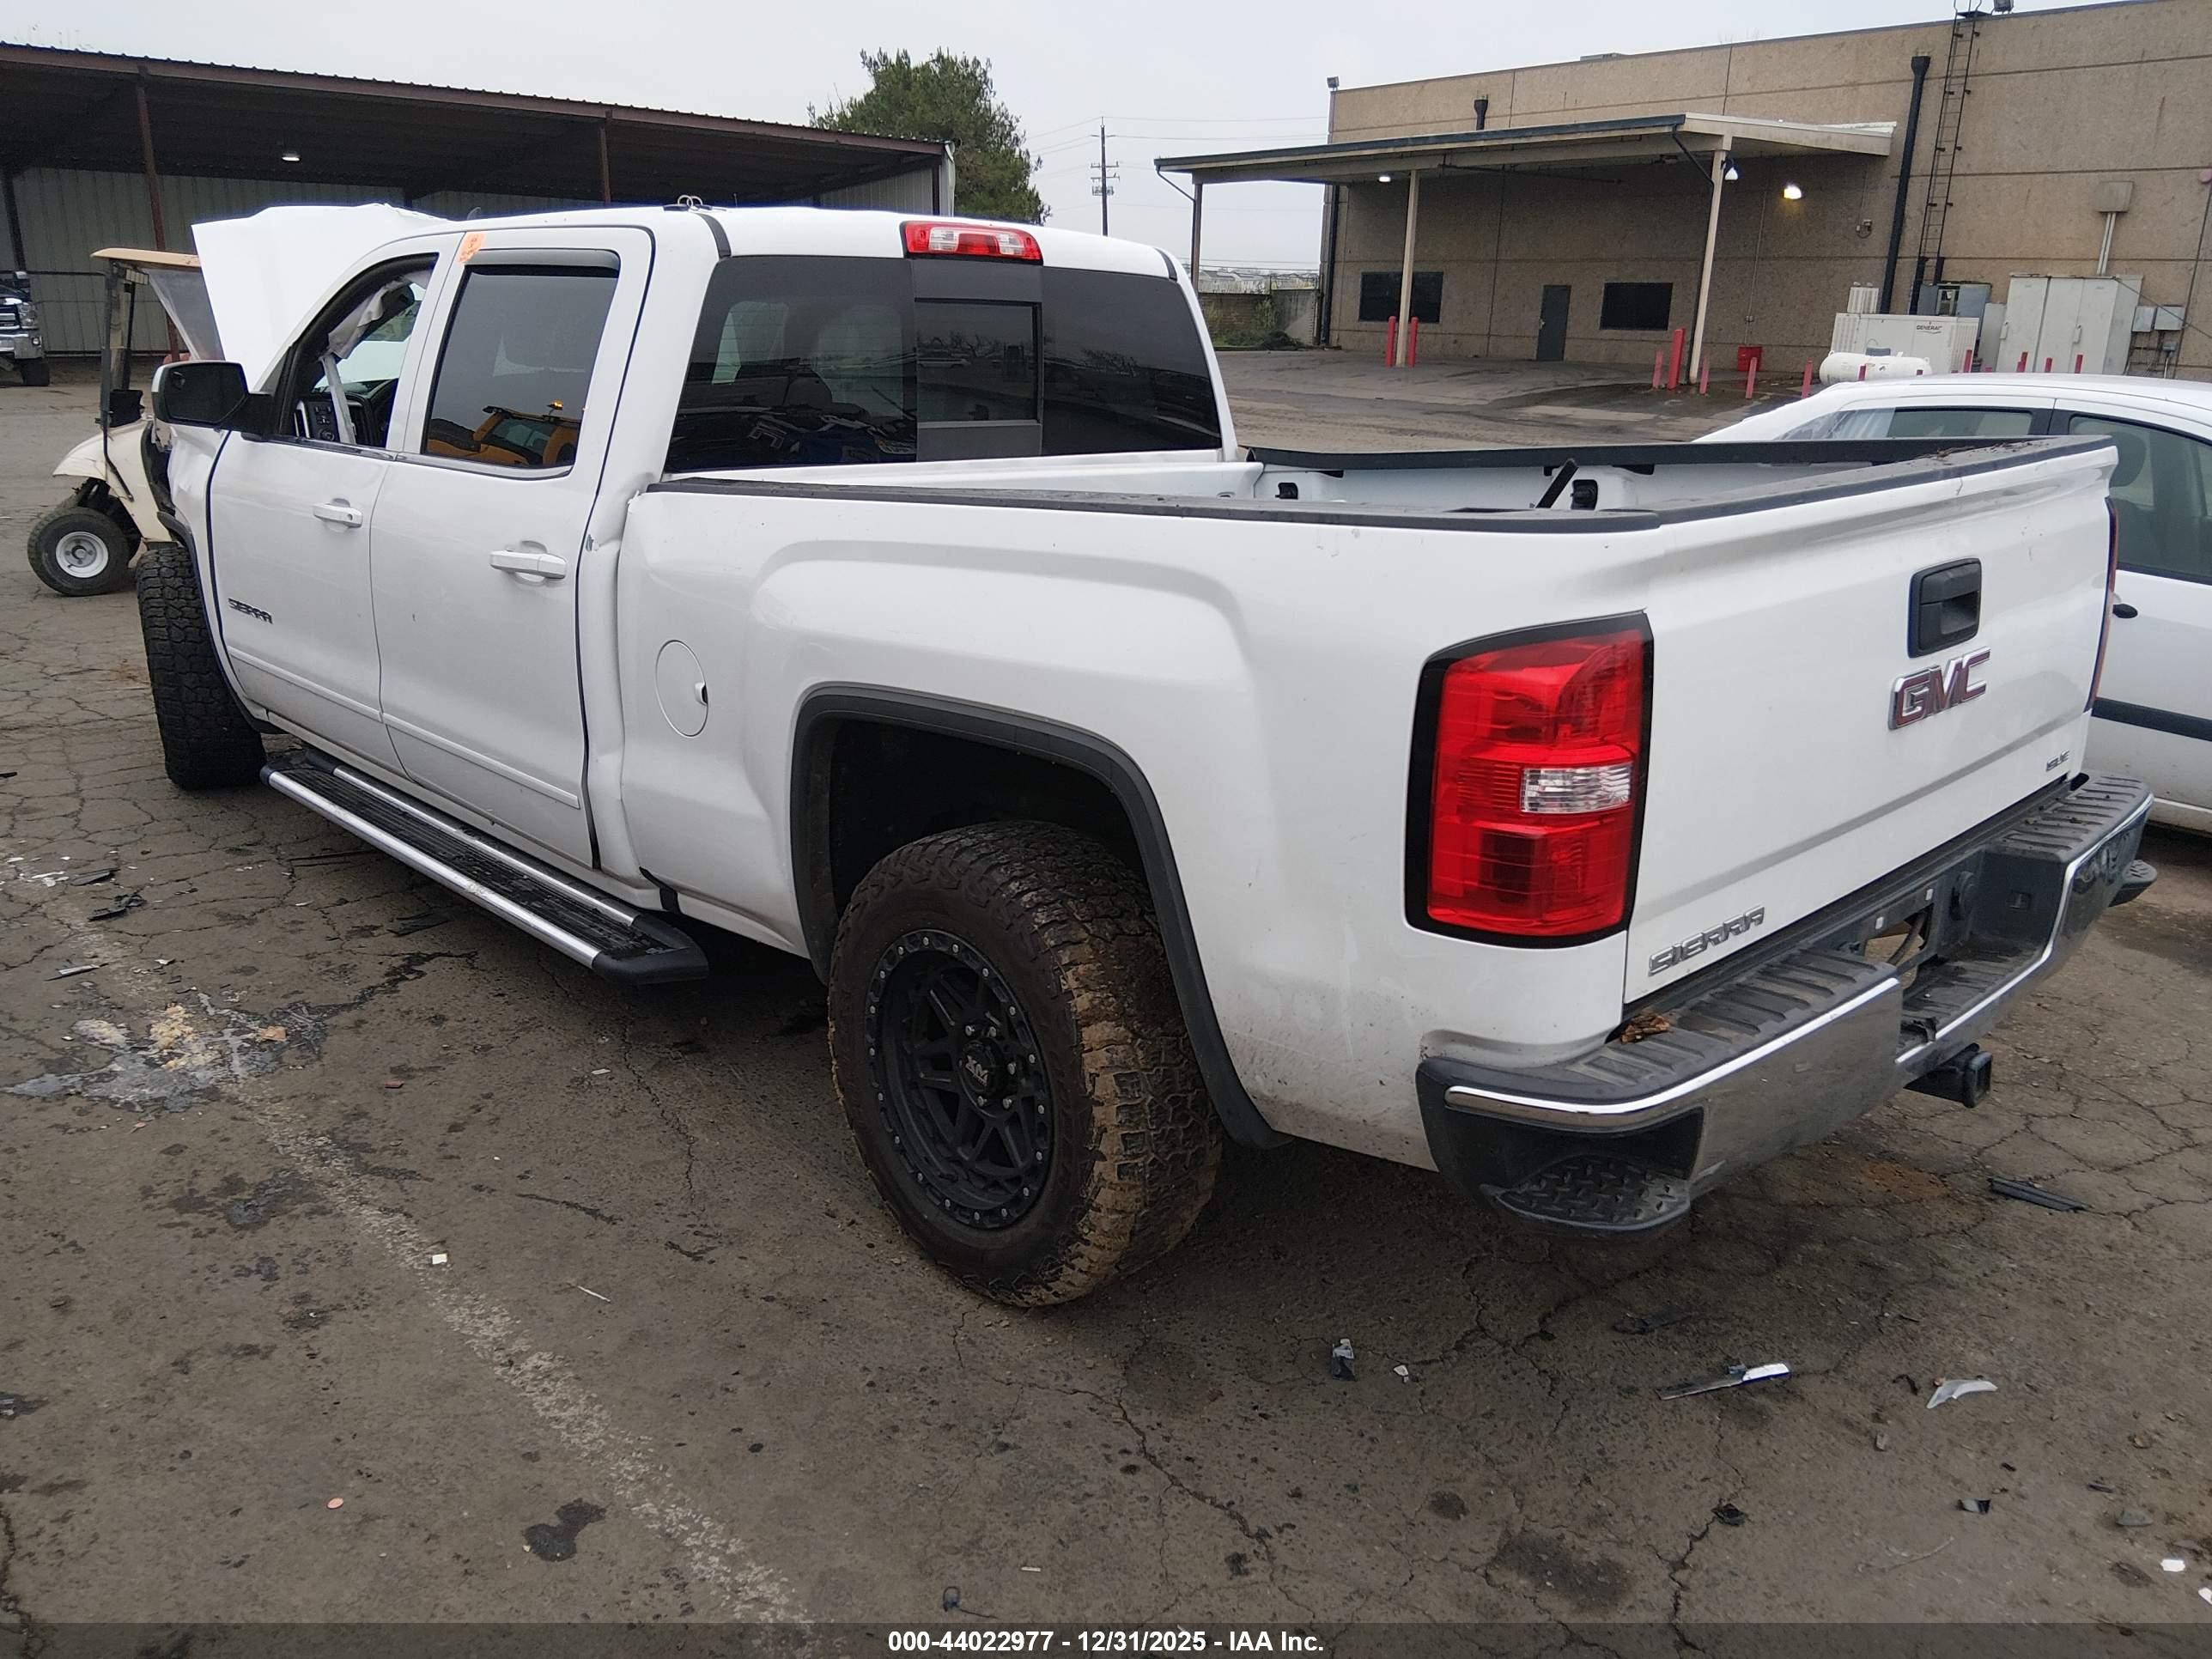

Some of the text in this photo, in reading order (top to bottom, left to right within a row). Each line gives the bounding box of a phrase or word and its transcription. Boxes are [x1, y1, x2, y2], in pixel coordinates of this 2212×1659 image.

[228, 598, 274, 624] SIERRA
[1887, 646, 1991, 730] GMC
[1647, 906, 1765, 977] SIERRA
